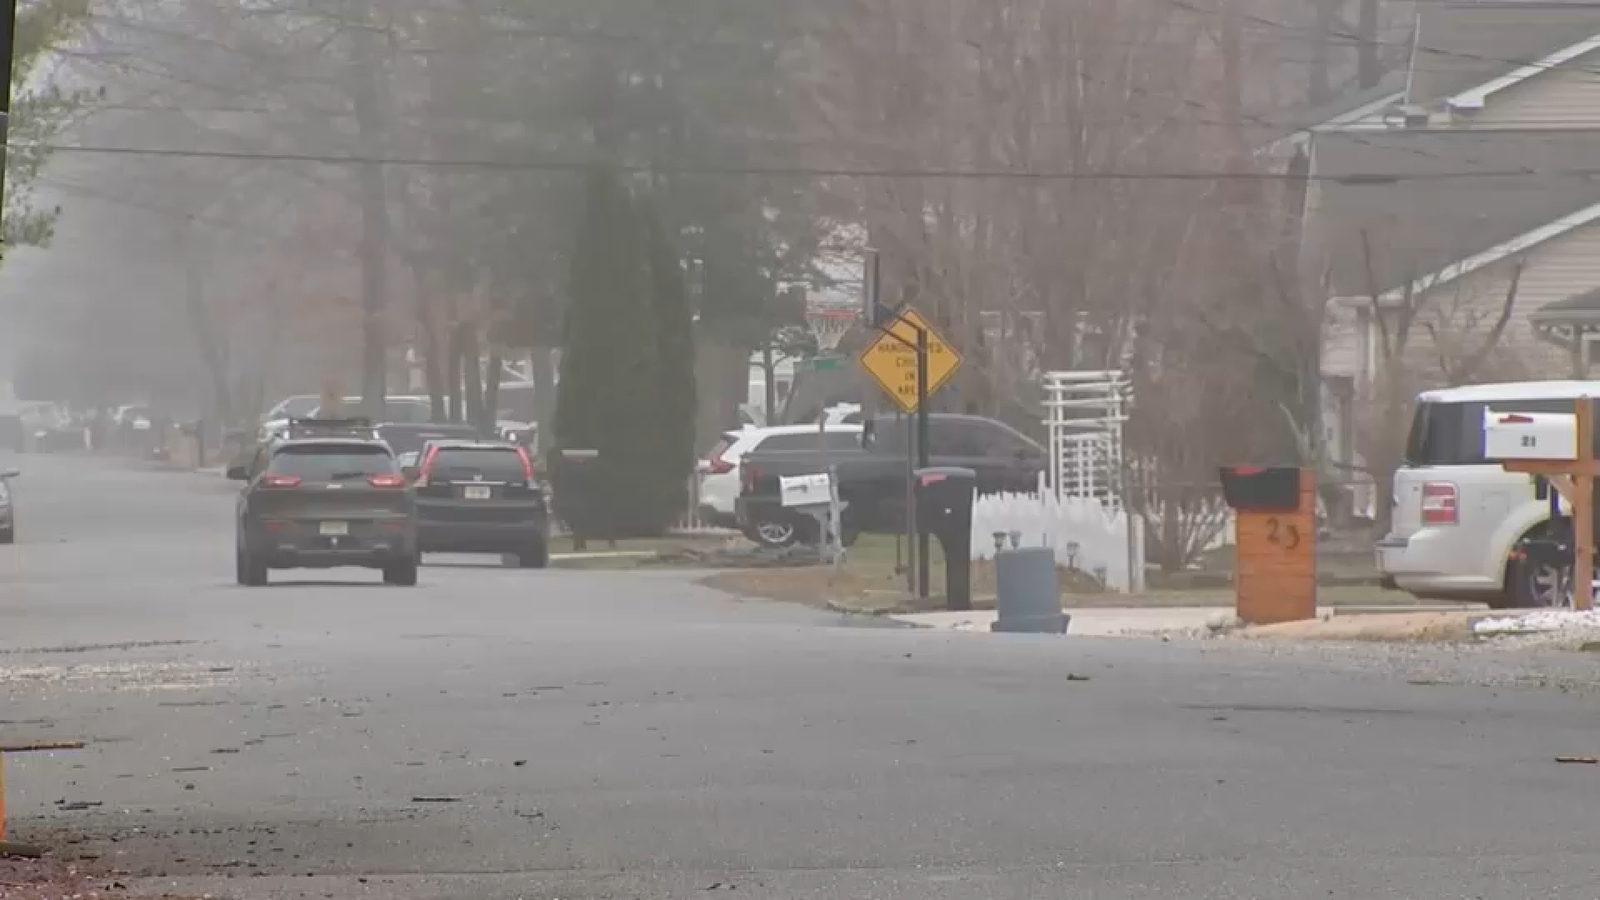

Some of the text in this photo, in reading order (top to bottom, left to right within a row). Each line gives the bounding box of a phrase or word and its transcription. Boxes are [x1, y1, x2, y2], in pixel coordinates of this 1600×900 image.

[878, 343, 943, 354] HANDIED
[896, 356, 919, 368] CHI
[898, 386, 919, 396] ARE
[1521, 436, 1536, 447] 21
